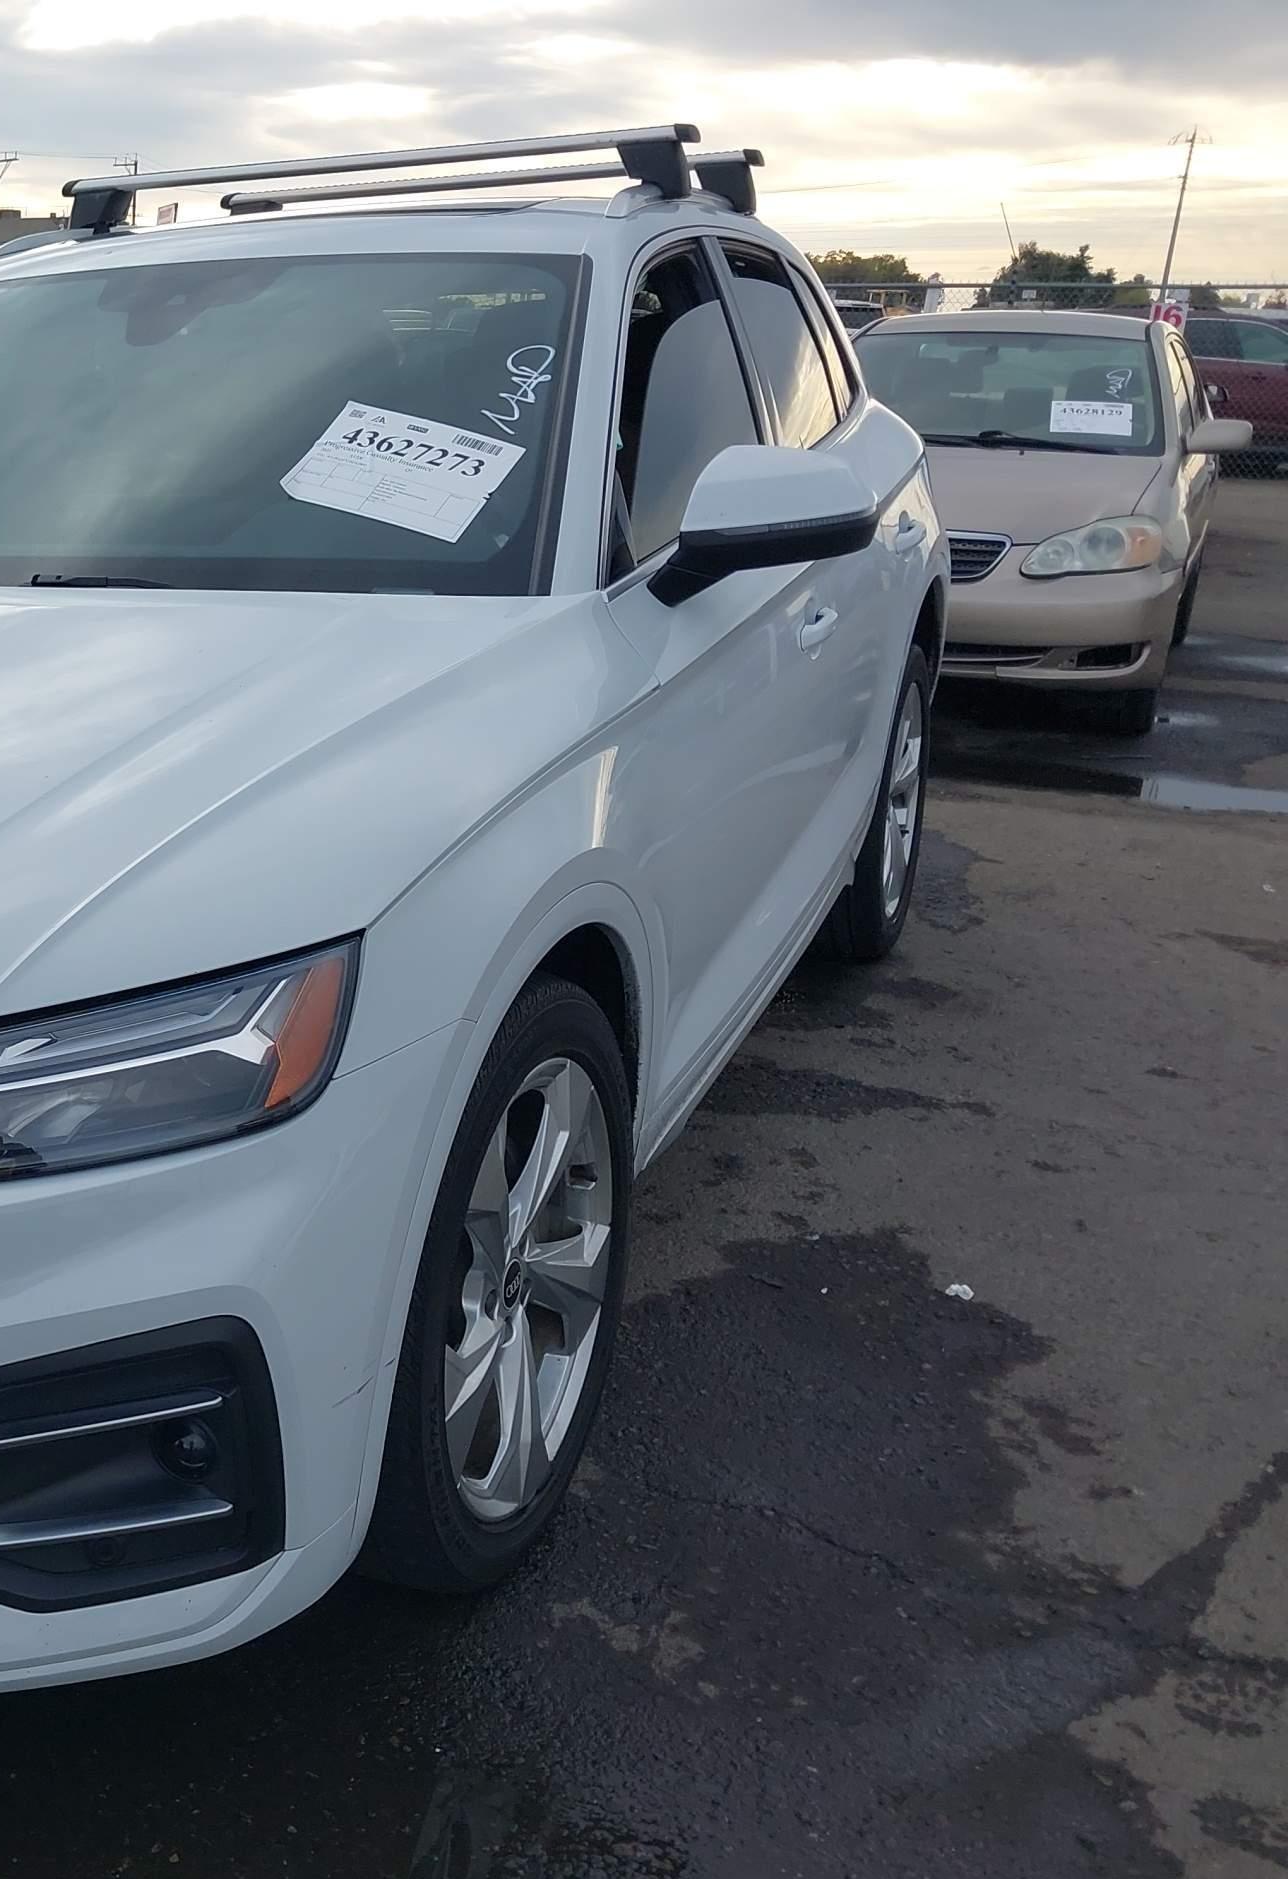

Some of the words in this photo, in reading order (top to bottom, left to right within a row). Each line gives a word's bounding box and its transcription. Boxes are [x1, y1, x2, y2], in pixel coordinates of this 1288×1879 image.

[1153, 304, 1183, 328] 16
[341, 427, 486, 477] 43627273
[398, 457, 435, 473] Insurance
